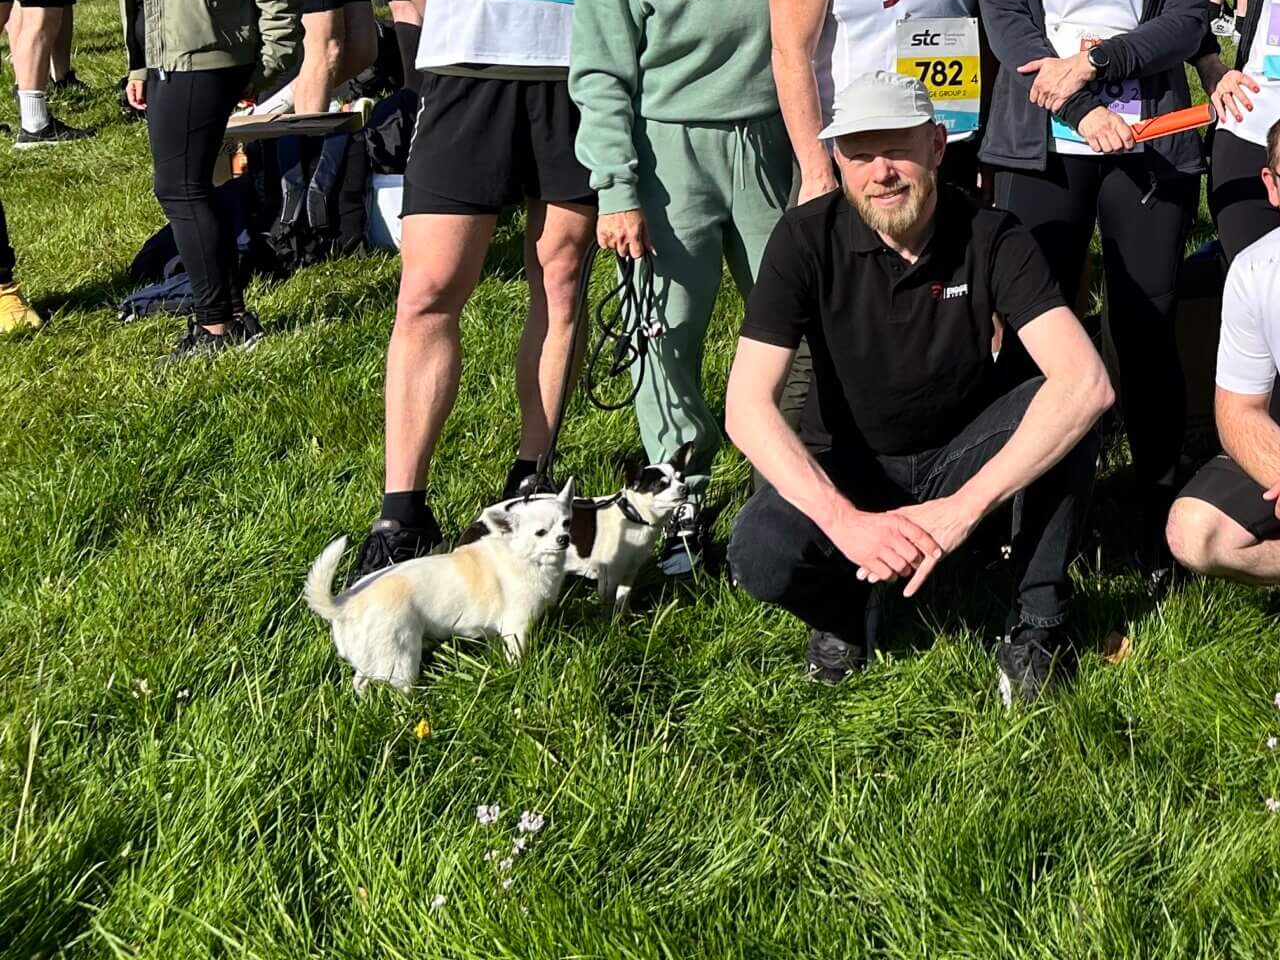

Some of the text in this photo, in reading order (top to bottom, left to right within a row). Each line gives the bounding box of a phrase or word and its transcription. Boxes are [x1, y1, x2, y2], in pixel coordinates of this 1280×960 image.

[910, 29, 942, 47] stc
[914, 59, 979, 87] 782 4
